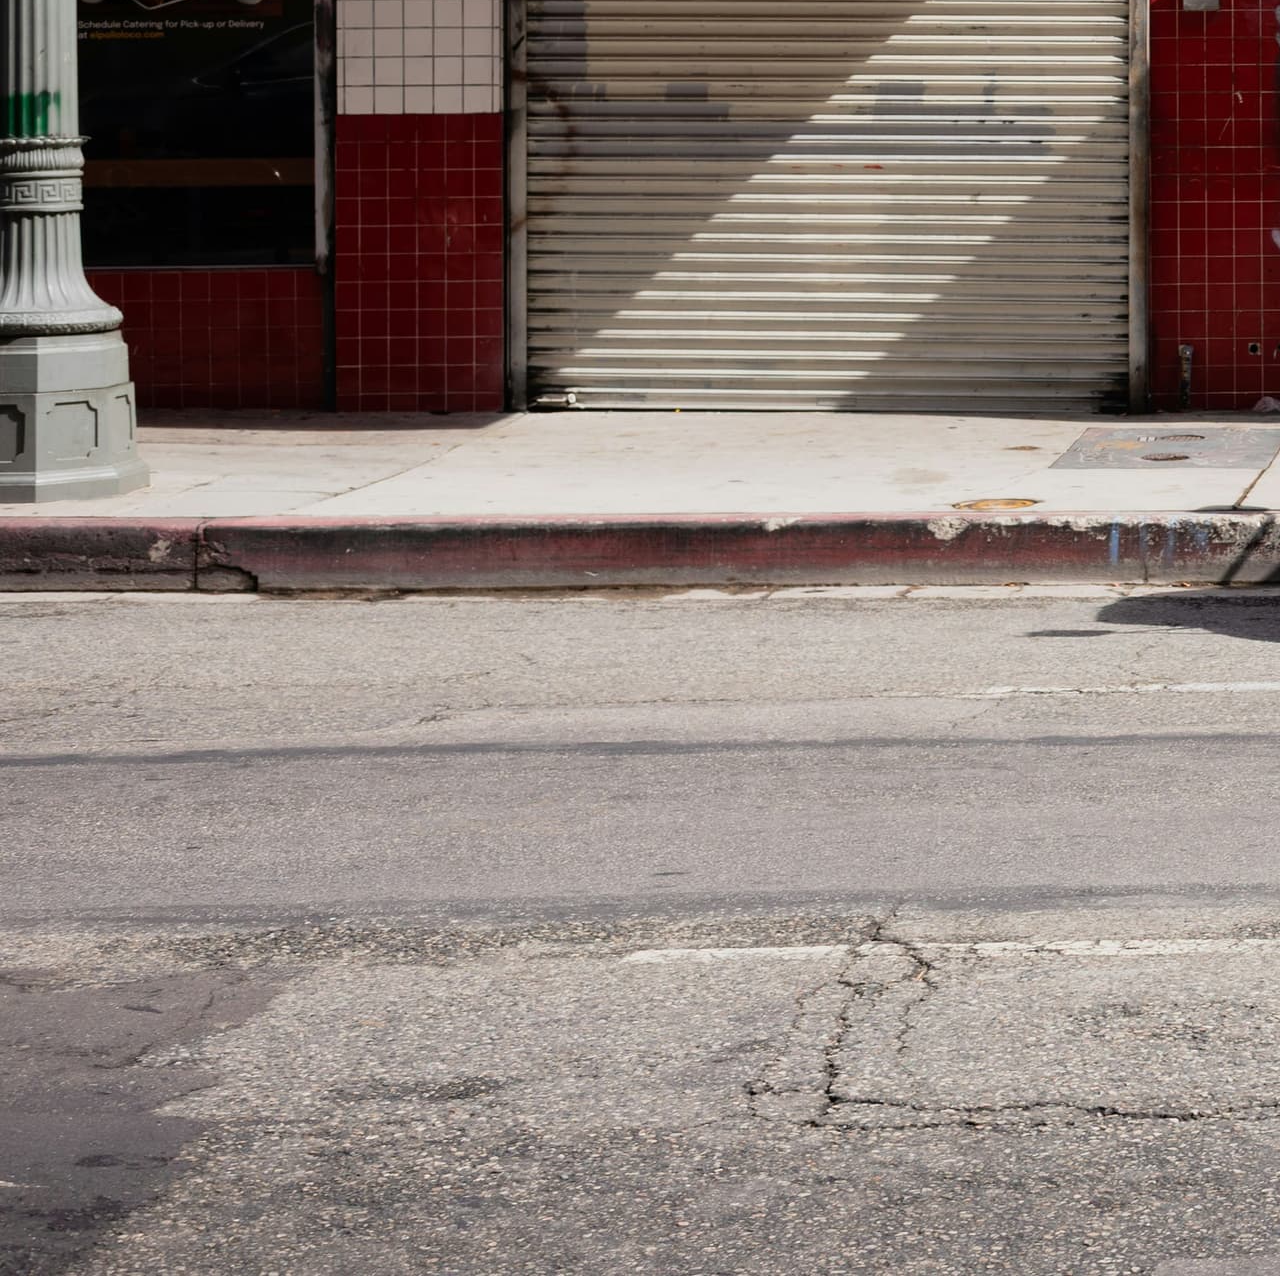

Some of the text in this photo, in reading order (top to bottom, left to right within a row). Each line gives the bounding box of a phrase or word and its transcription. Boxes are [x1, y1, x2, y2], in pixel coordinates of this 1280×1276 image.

[78, 19, 265, 32] Schedule Catering for Pick-up or Delivery
